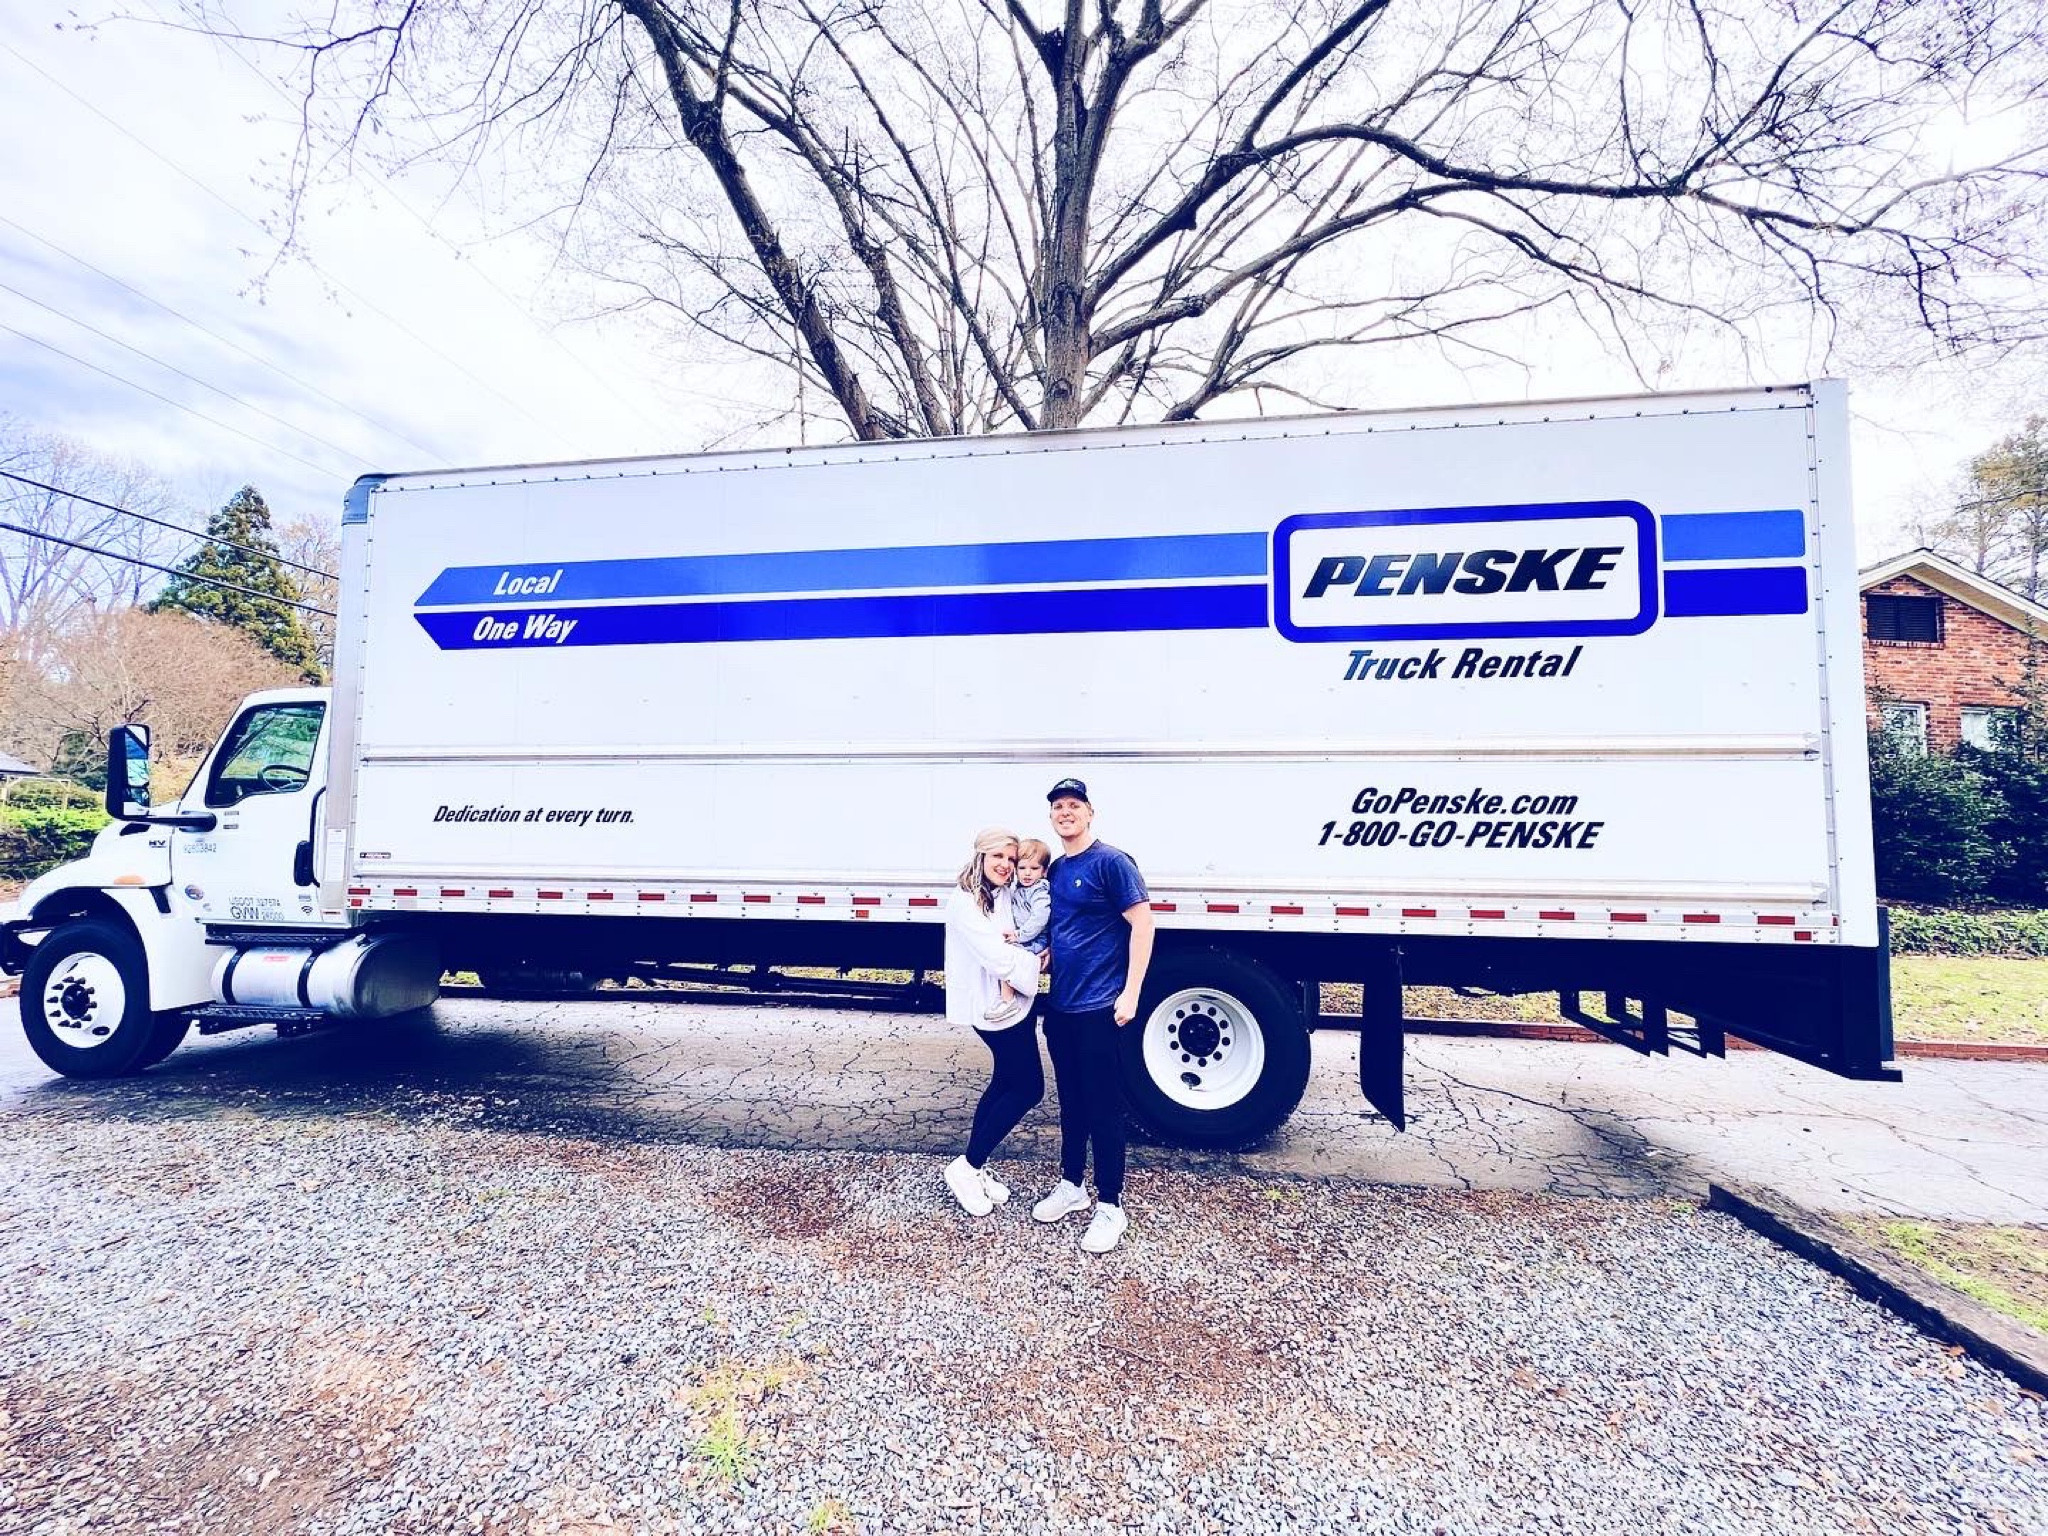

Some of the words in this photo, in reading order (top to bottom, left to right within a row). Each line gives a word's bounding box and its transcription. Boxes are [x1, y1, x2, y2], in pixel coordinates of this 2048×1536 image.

[493, 569, 564, 595] Local
[1303, 547, 1625, 598] PENSKE
[473, 616, 519, 641] One
[523, 613, 579, 644] Way
[1344, 648, 1447, 681] Truck
[1452, 645, 1584, 679] Rental
[1351, 787, 1579, 815] GoPenske.com
[433, 805, 521, 823] Dedication
[524, 807, 544, 823] at
[545, 808, 594, 827] every
[595, 807, 635, 823] turn.
[1317, 820, 1605, 849] 1-800-GO-PENSKE
